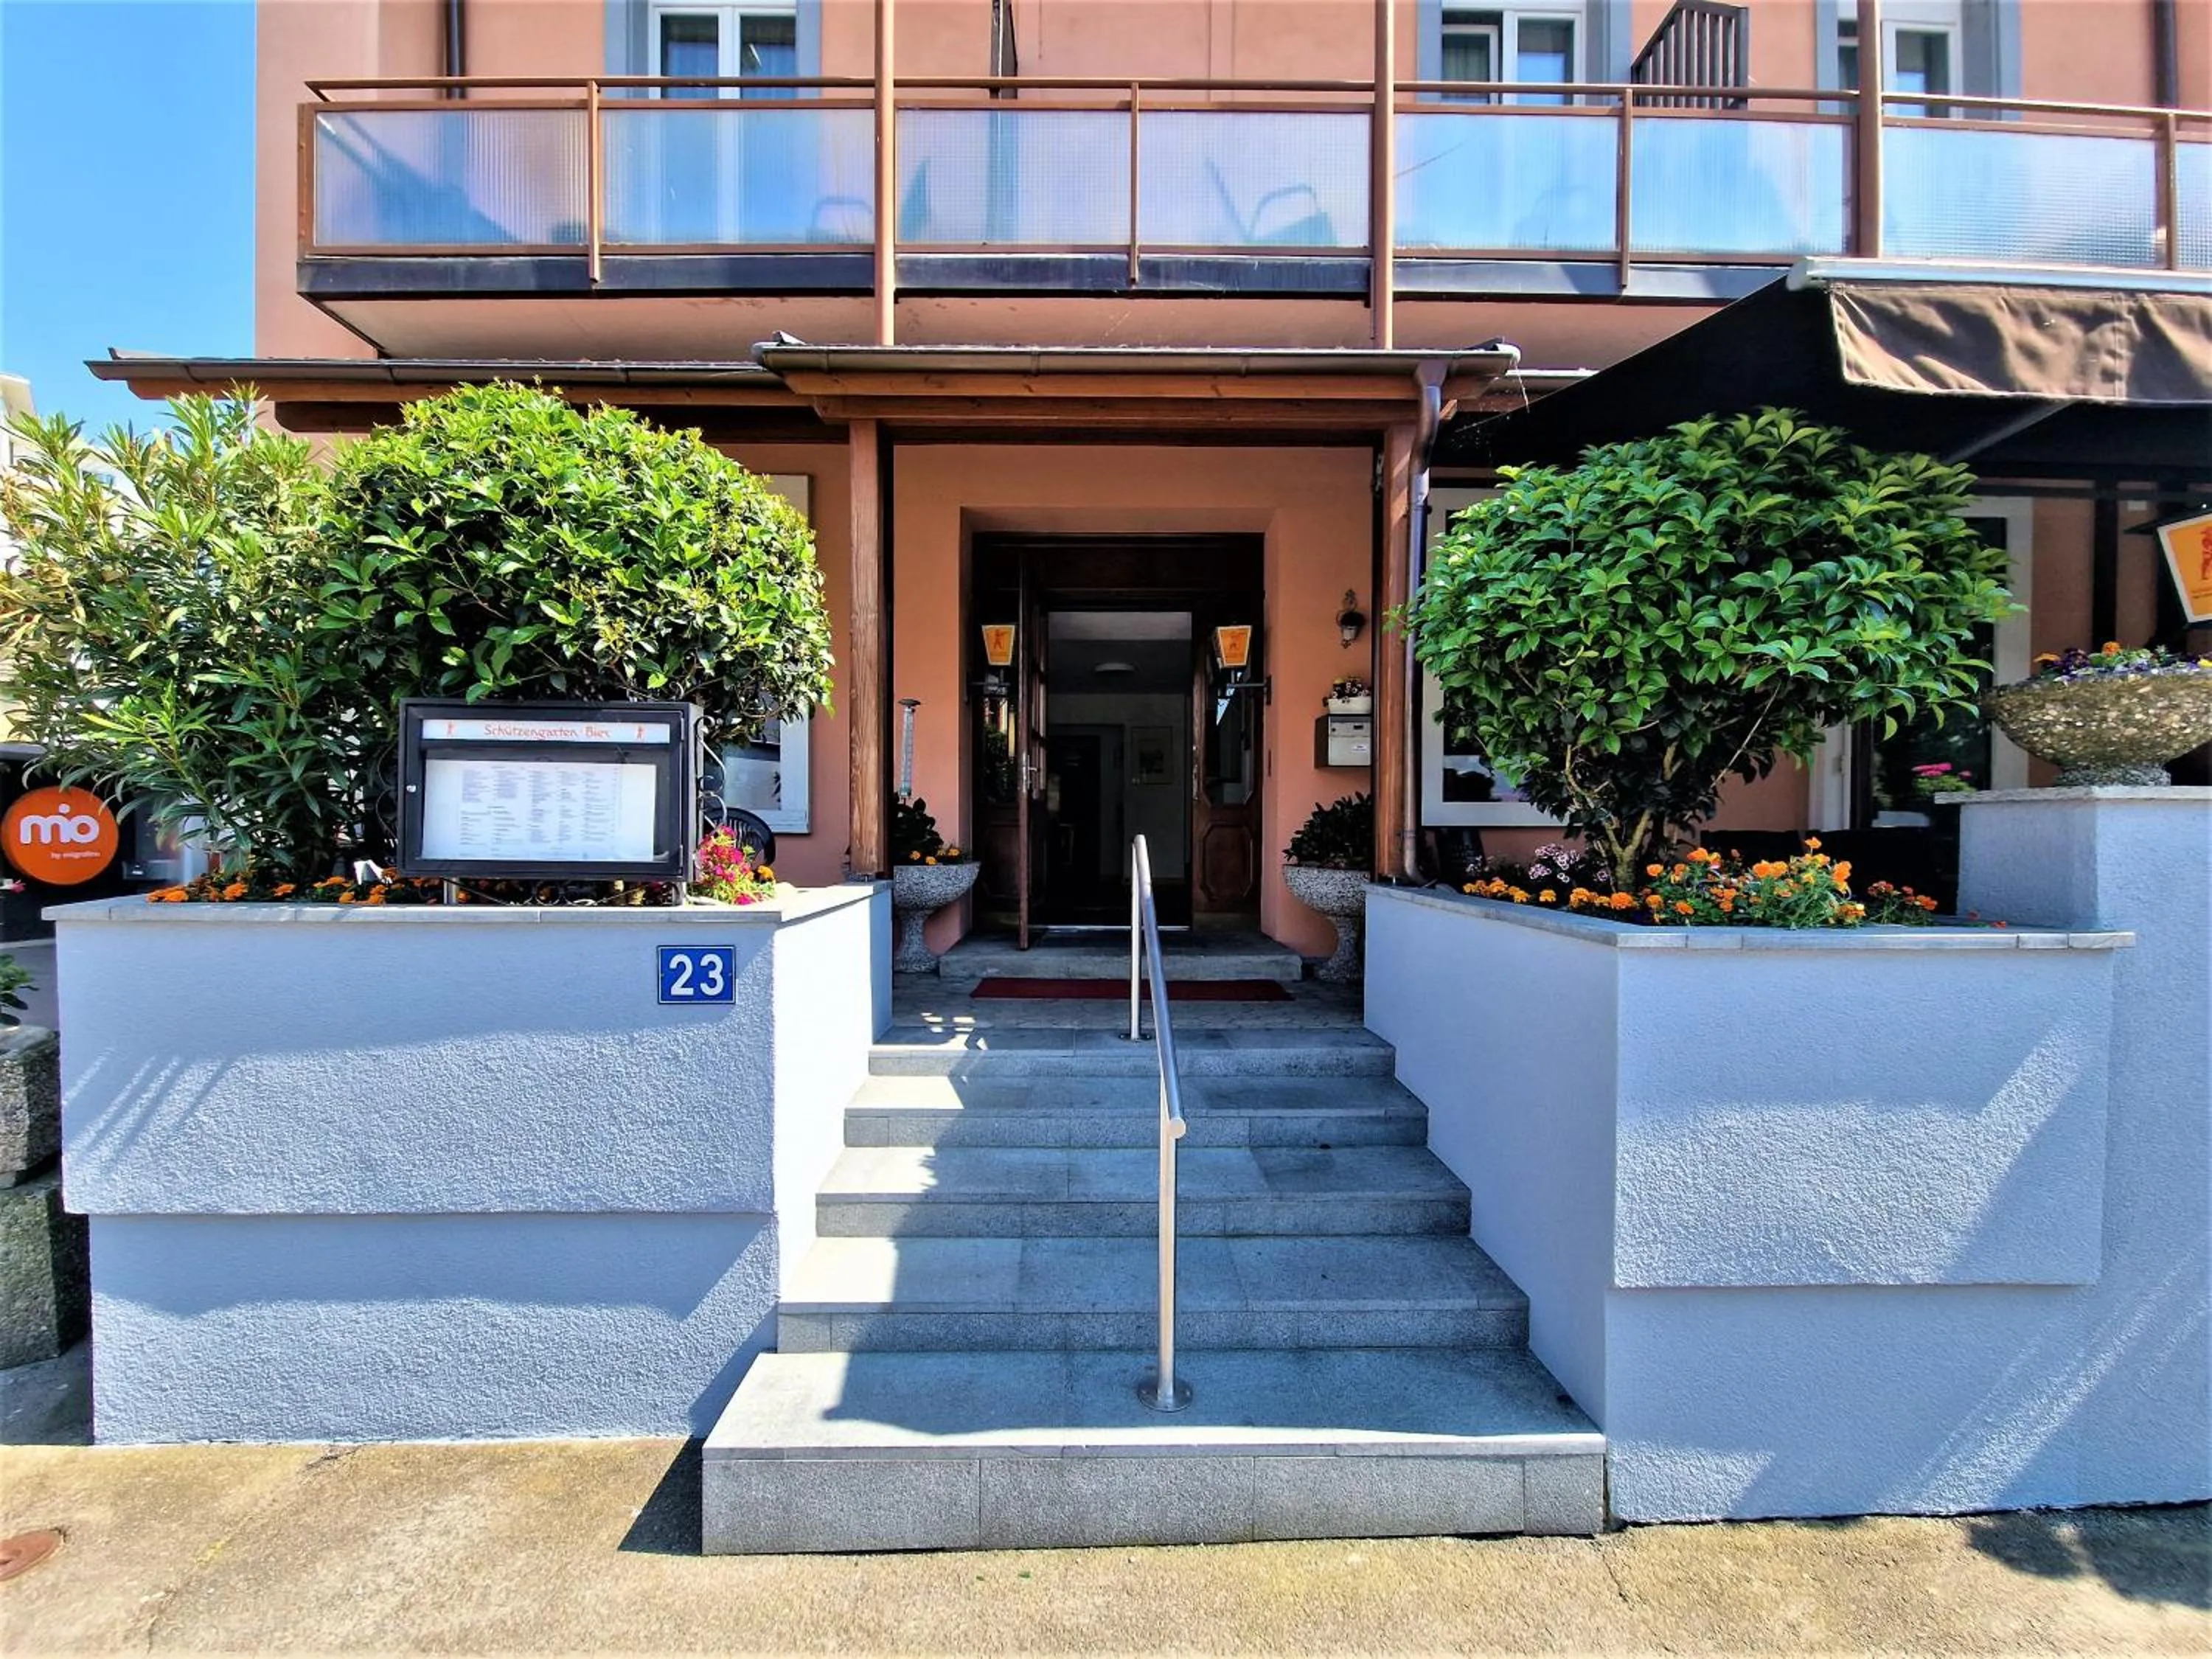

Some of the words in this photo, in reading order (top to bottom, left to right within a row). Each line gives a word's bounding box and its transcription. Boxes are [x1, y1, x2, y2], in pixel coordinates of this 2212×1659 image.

[585, 726, 611, 738] Bier
[20, 803, 100, 844] mio
[669, 953, 724, 996] 23
